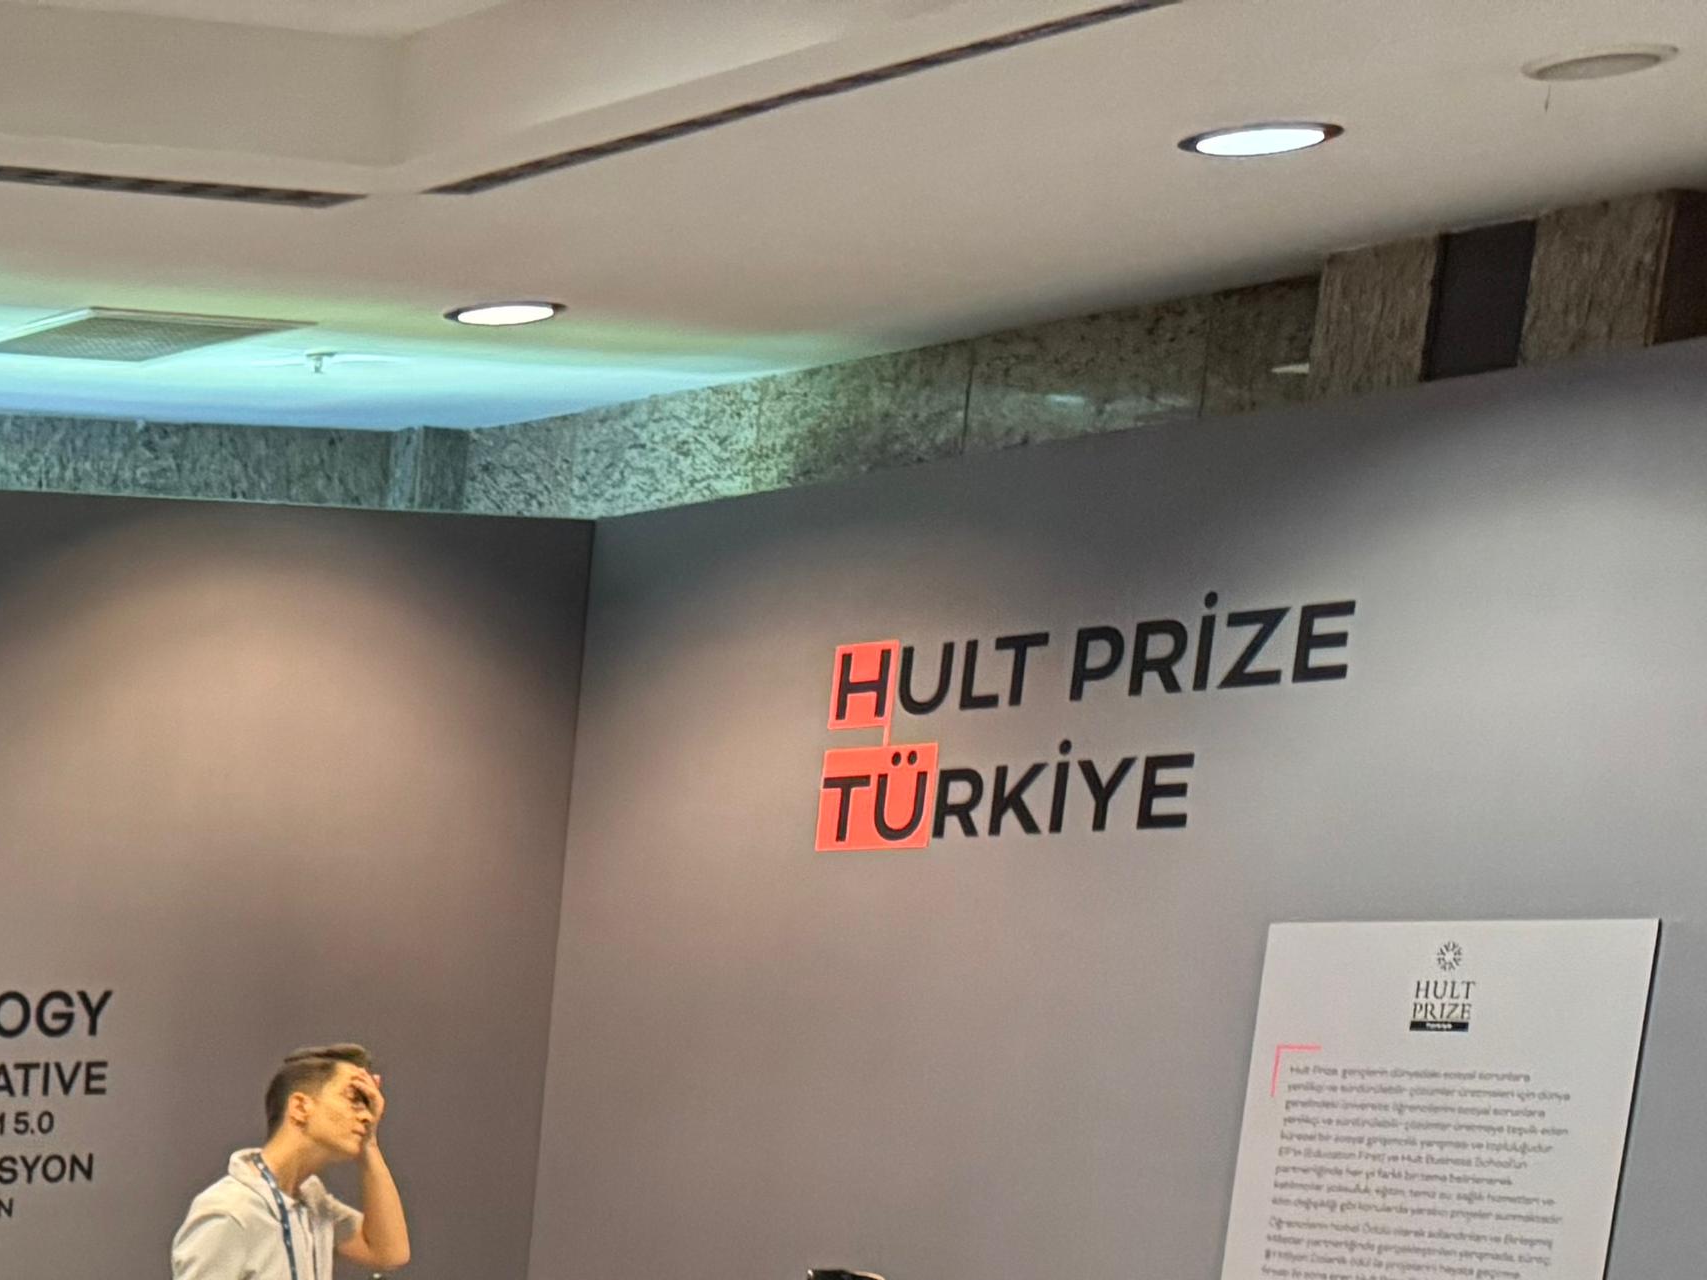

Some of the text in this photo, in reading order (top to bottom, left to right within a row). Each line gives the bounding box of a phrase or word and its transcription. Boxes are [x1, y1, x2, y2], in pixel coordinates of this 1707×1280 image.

[835, 591, 1356, 720] HULT PRİZE
[823, 739, 1195, 843] TÜRKİYE
[1415, 981, 1475, 999] HULT
[1412, 1002, 1471, 1020] PRIZE
[12, 1110, 55, 1137] 5.0
